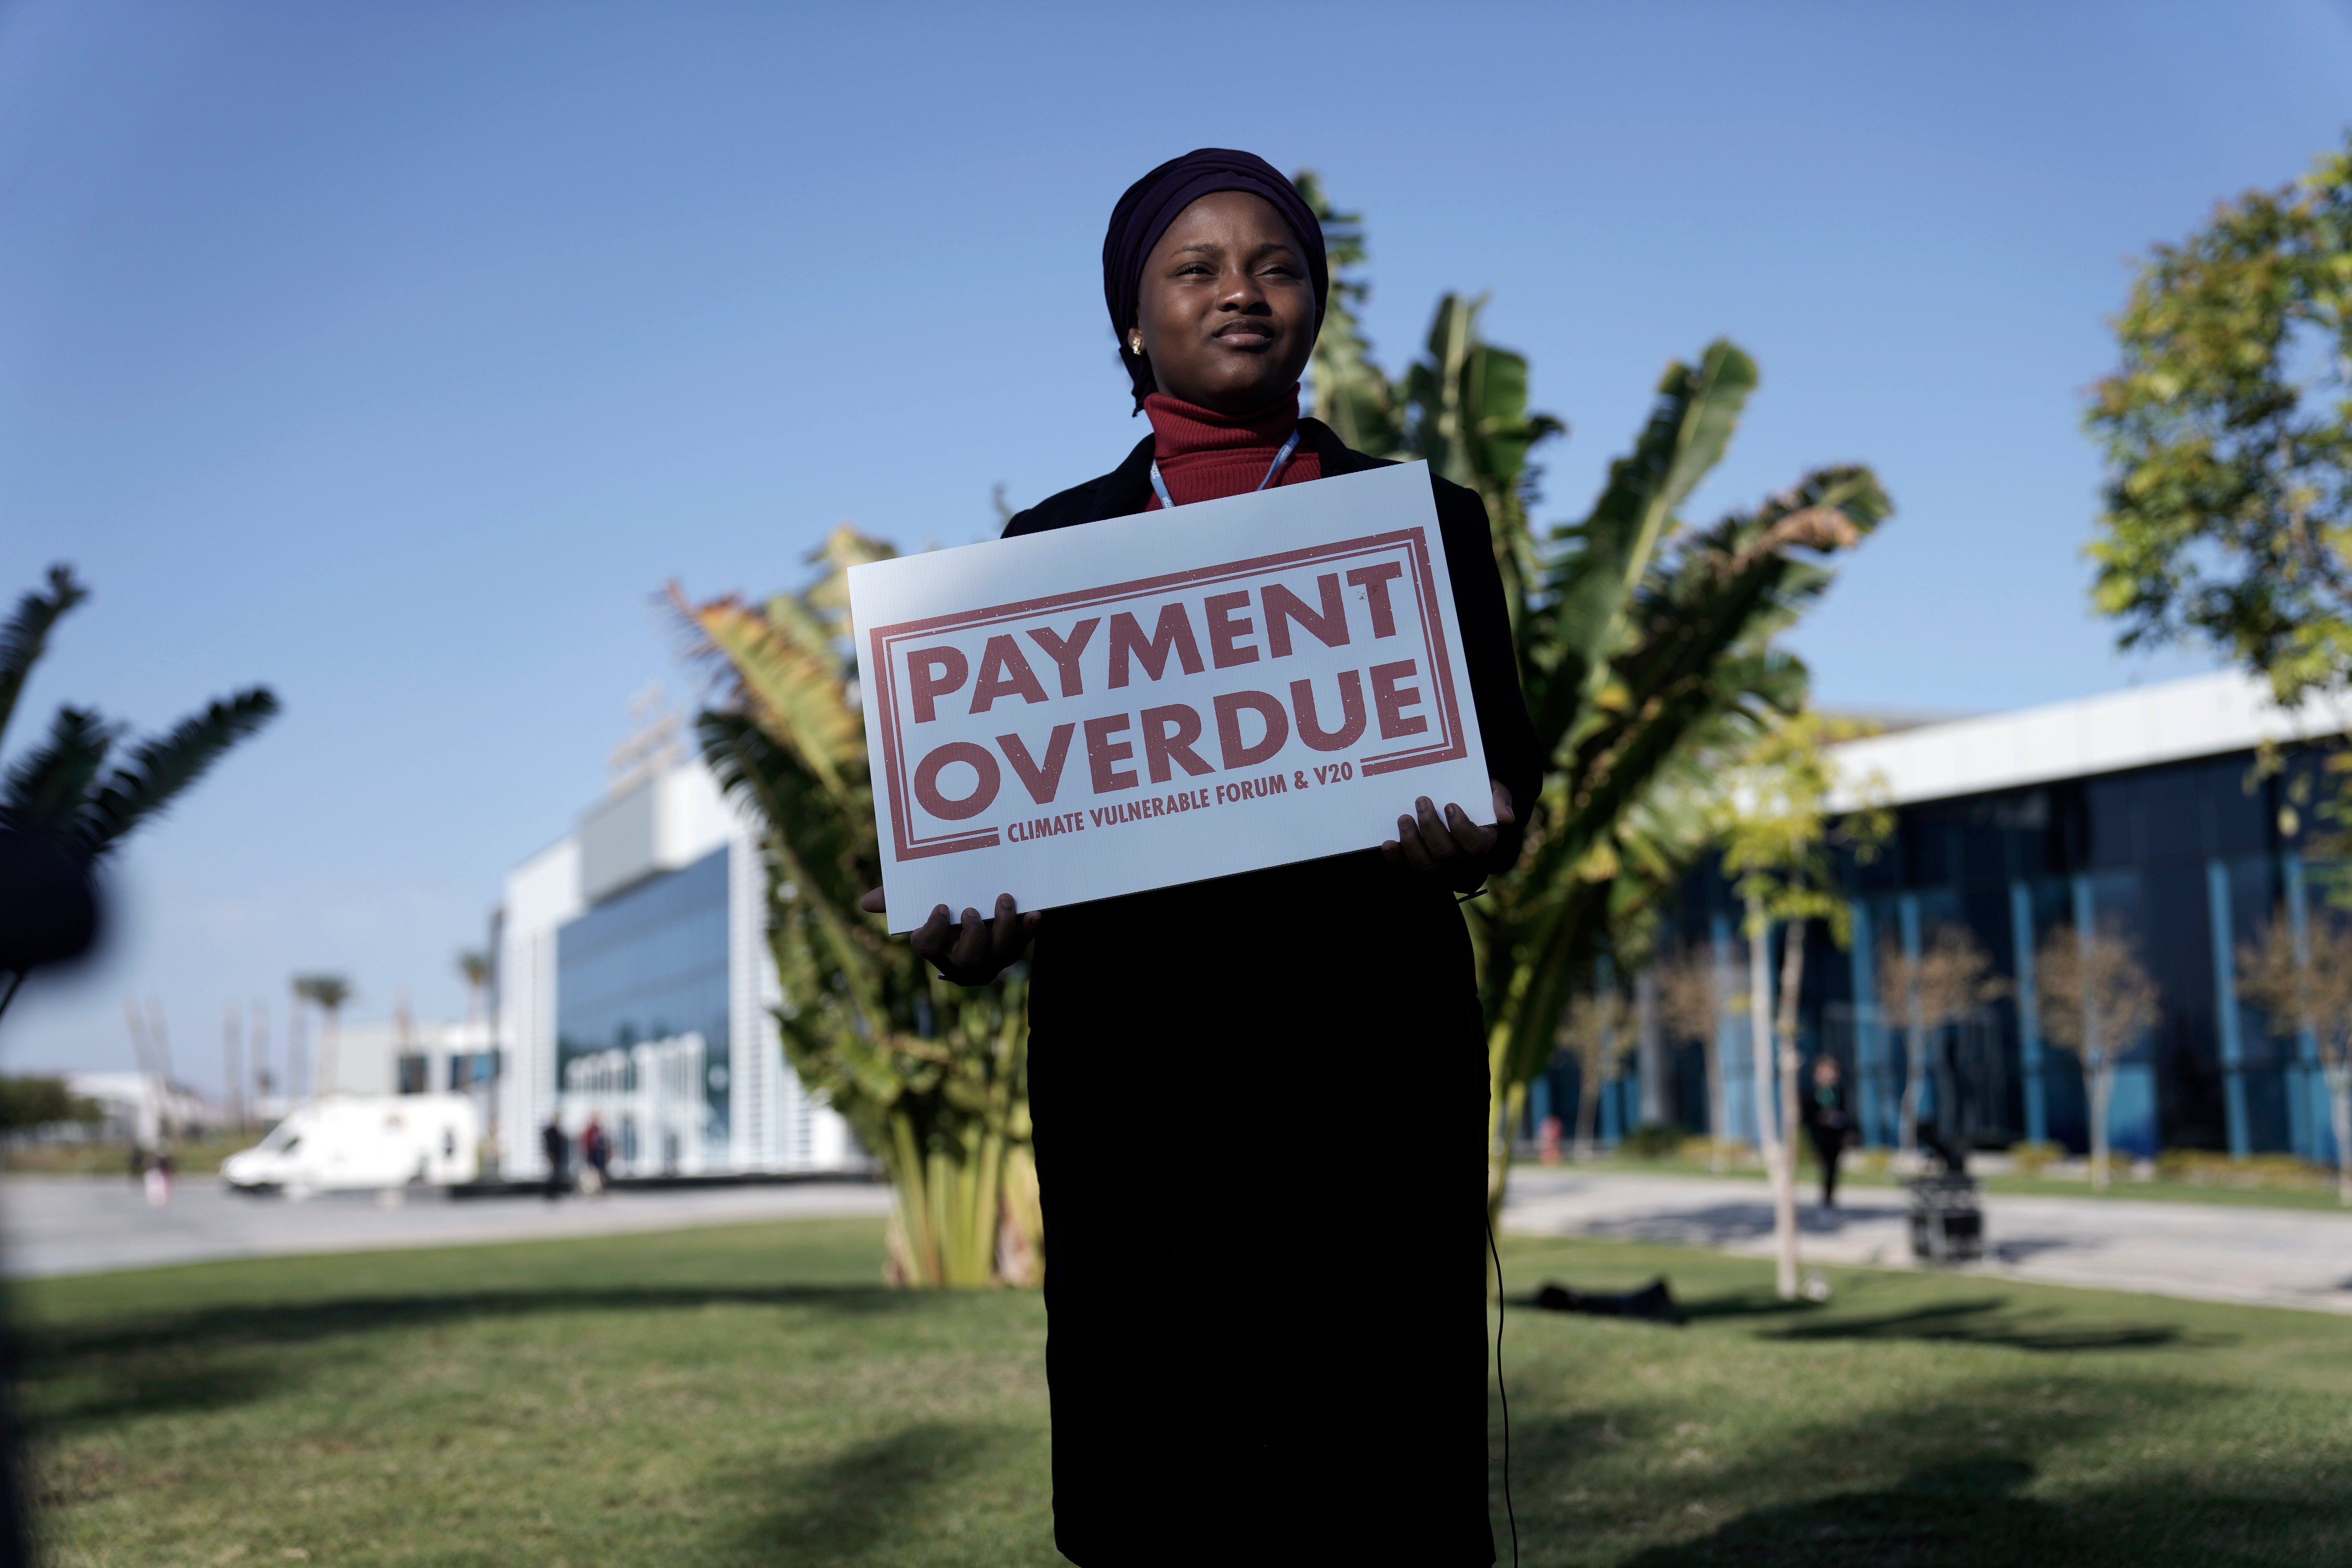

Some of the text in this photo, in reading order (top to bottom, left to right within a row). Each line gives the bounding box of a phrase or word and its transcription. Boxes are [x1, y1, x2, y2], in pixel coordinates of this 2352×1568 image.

[907, 561, 1402, 724] PAYMENT
[914, 659, 1428, 821] OVERDUE
[1008, 762, 1353, 843] CLIMATE VULNERABLE FORUM & V20
